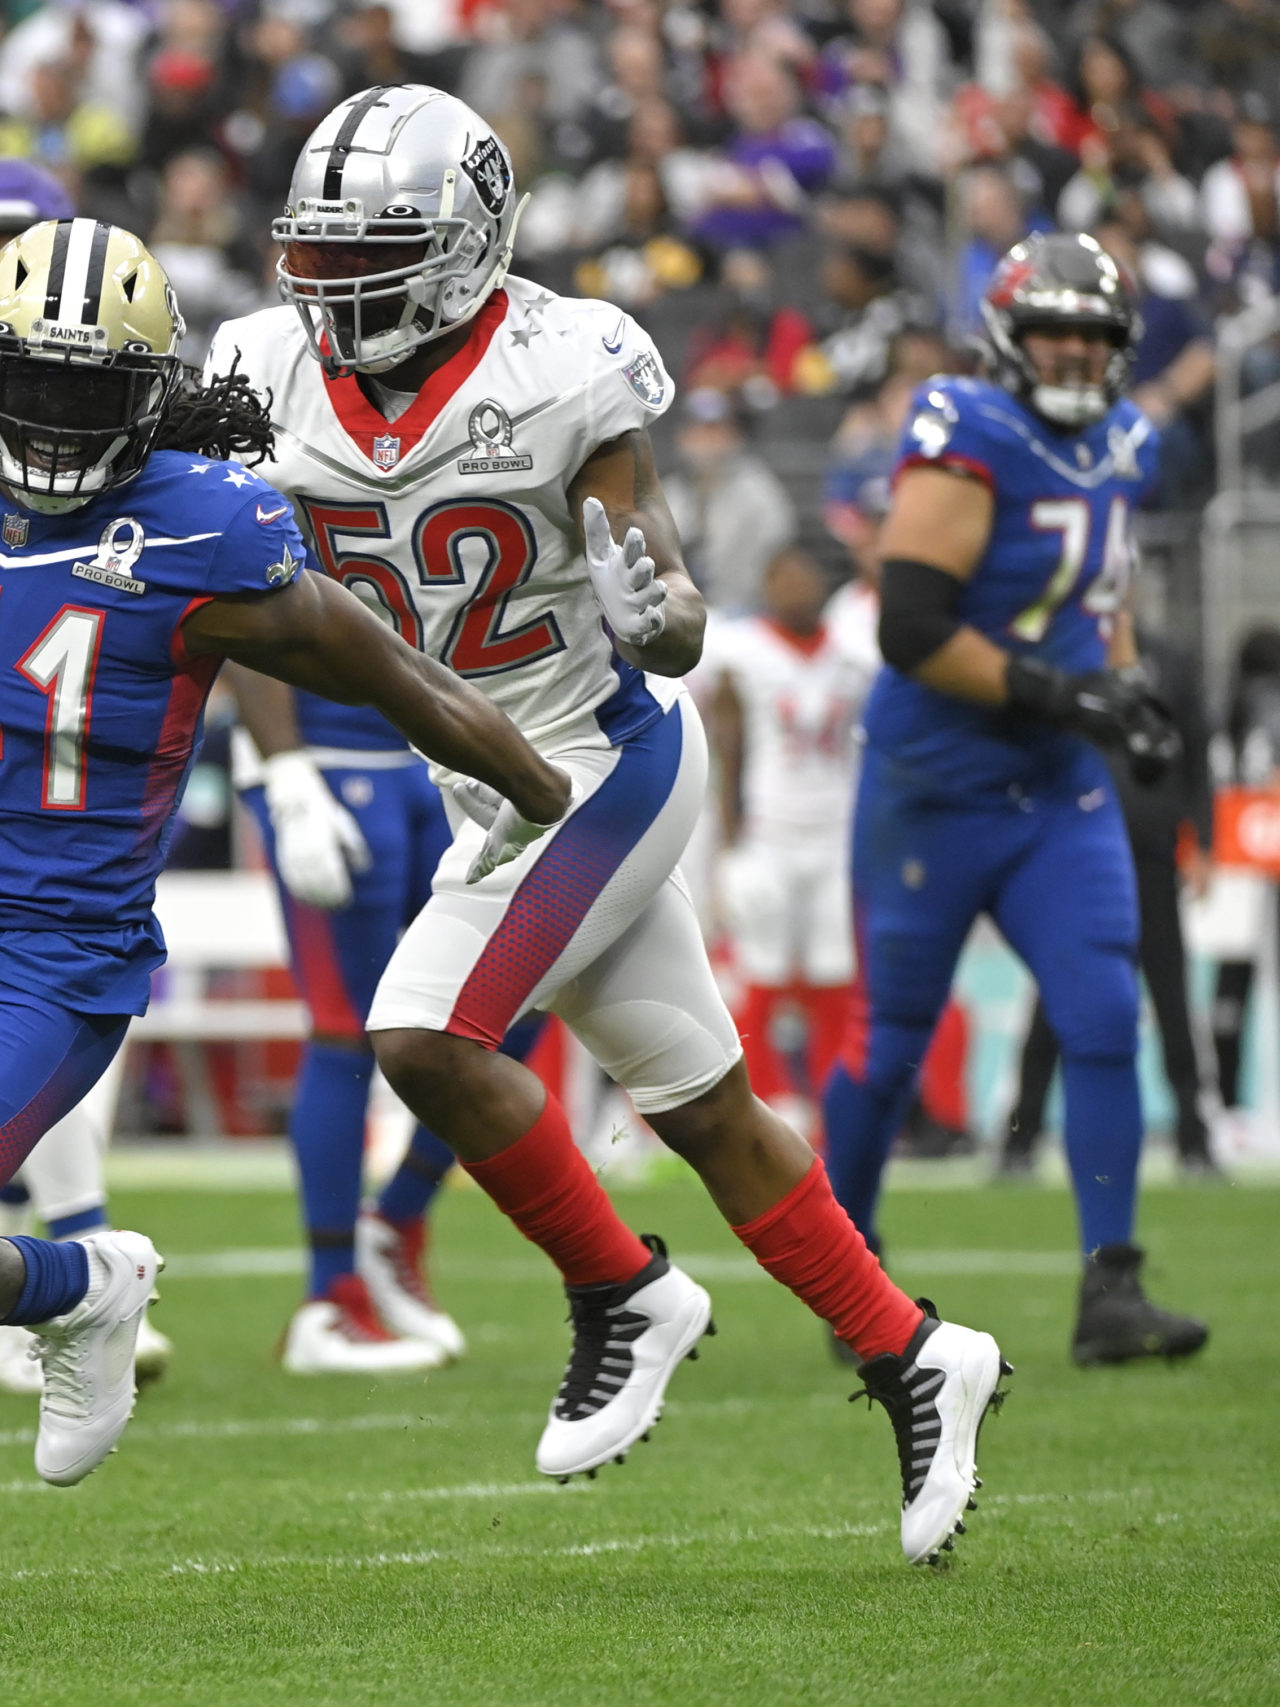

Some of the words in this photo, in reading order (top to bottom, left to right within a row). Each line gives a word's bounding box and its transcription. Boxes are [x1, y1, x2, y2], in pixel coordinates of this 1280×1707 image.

[49, 326, 90, 343] SAINTS
[462, 462, 489, 472] PRO
[492, 460, 530, 470] BOWL
[75, 565, 102, 581] PRO
[105, 575, 142, 593] BOWL
[295, 494, 568, 681] 52
